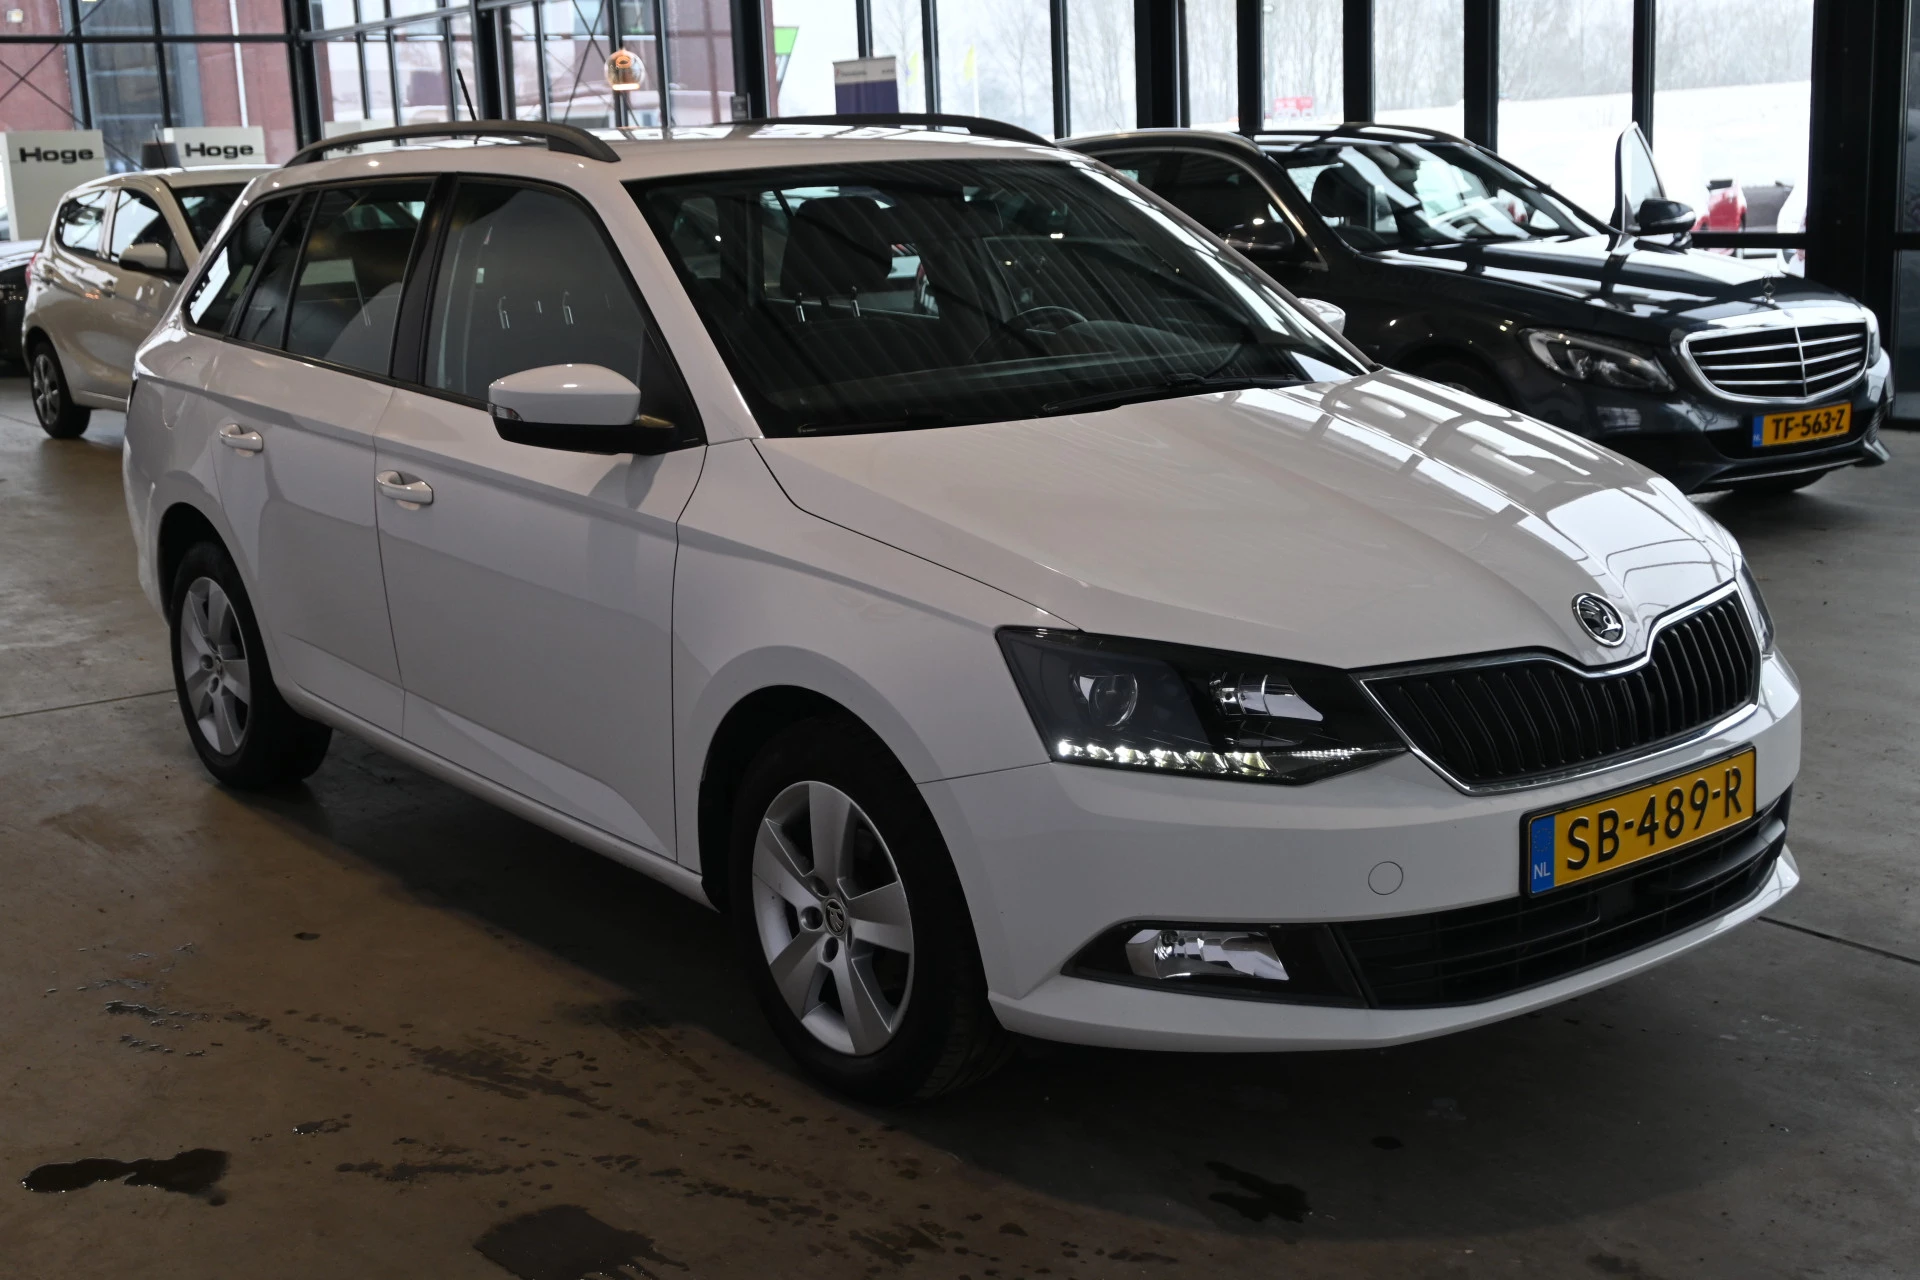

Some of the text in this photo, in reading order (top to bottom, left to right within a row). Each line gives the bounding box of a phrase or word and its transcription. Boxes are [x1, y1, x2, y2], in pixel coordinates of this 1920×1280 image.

[19, 146, 94, 164] Hoge
[185, 142, 254, 158] Hoge
[1772, 408, 1845, 440] TF-563-Z
[1566, 765, 1743, 871] SB-489-R
[1533, 861, 1551, 880] NL
